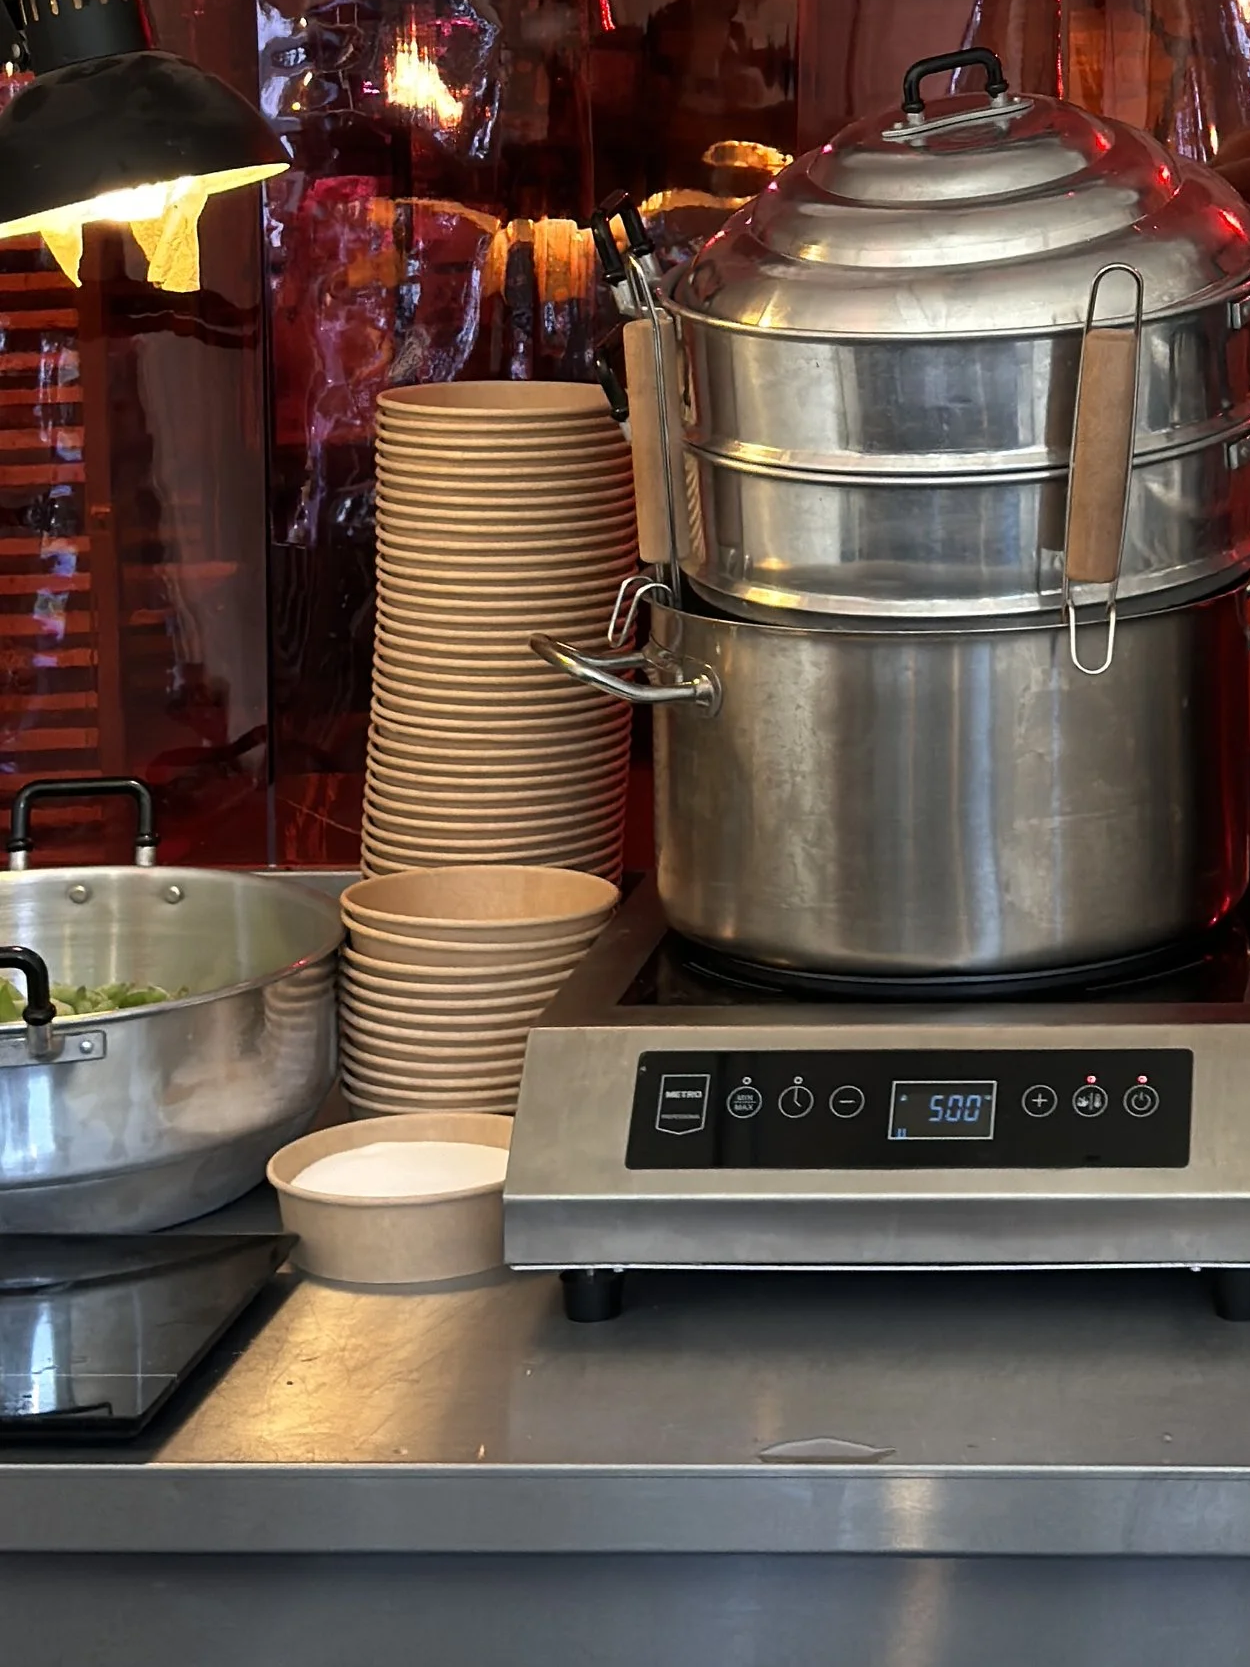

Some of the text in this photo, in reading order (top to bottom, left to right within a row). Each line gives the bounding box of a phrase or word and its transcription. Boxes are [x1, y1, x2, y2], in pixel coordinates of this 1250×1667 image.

[664, 1090, 703, 1099] METRO
[734, 1103, 754, 1111] MAX
[928, 1093, 983, 1123] 500
